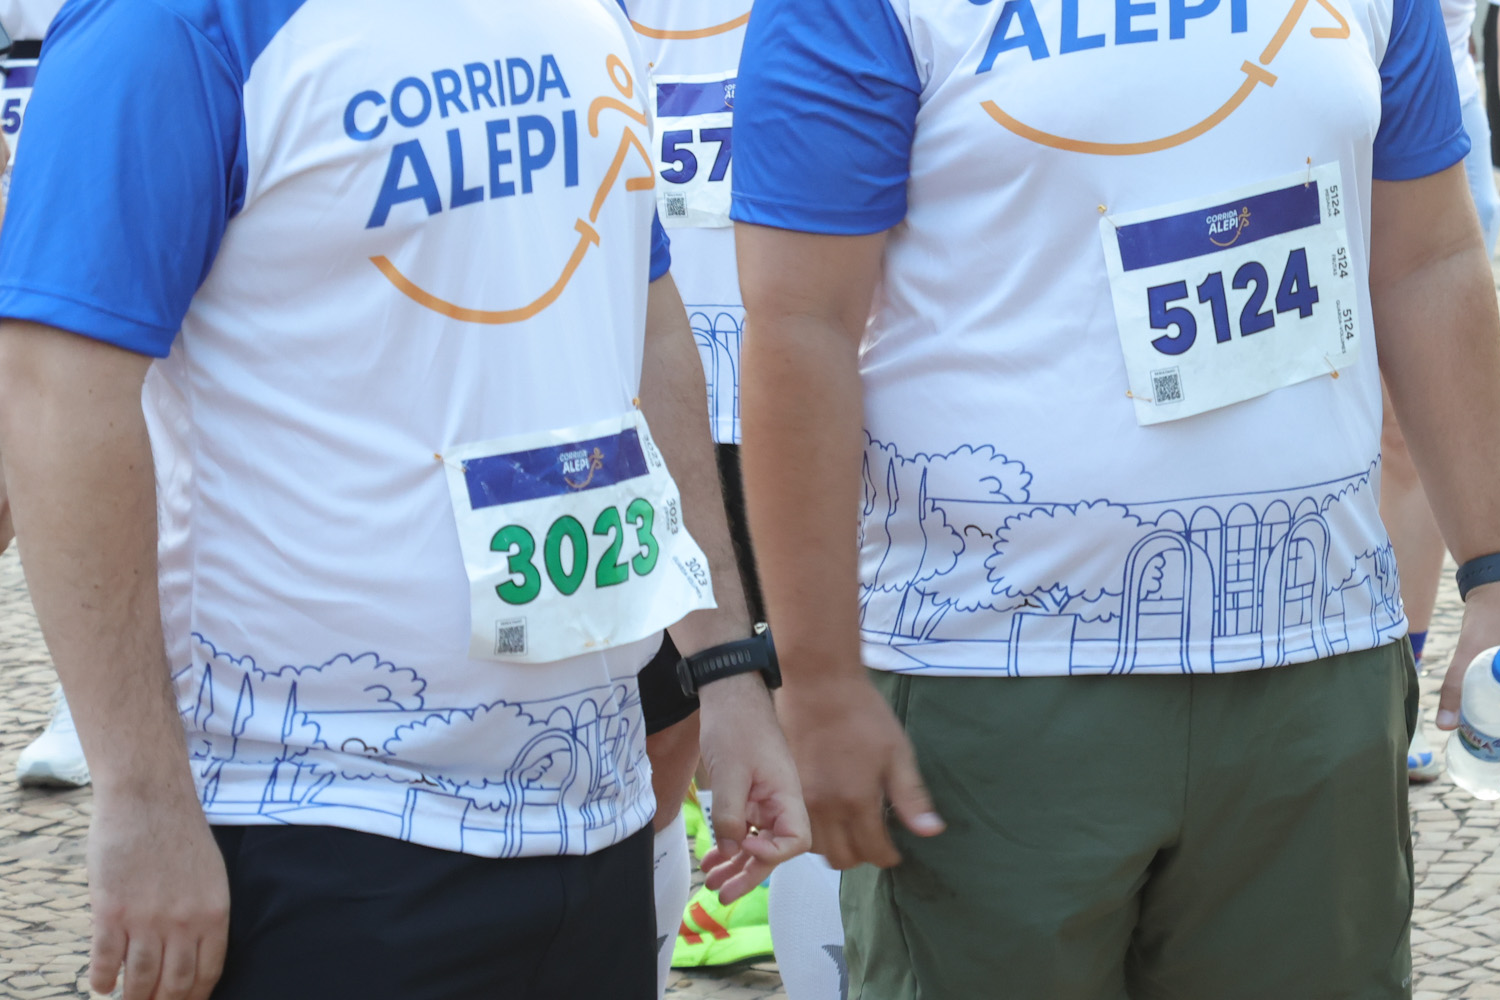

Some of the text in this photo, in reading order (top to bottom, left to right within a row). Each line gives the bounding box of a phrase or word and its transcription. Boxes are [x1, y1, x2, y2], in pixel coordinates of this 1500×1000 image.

[343, 54, 571, 141] CORRIDA
[364, 109, 579, 229] ALEPI
[660, 127, 733, 184] 57
[1206, 209, 1238, 224] CORRIDA
[1330, 185, 1340, 217] 5124
[1208, 216, 1239, 235] ALEPI
[1337, 247, 1348, 279] 5124
[1146, 247, 1319, 355] 5124
[1343, 308, 1354, 340] 5124
[562, 458, 590, 474] ALEPI
[666, 498, 679, 535] 3023
[490, 497, 659, 605] 3023
[685, 557, 708, 587] 3023
